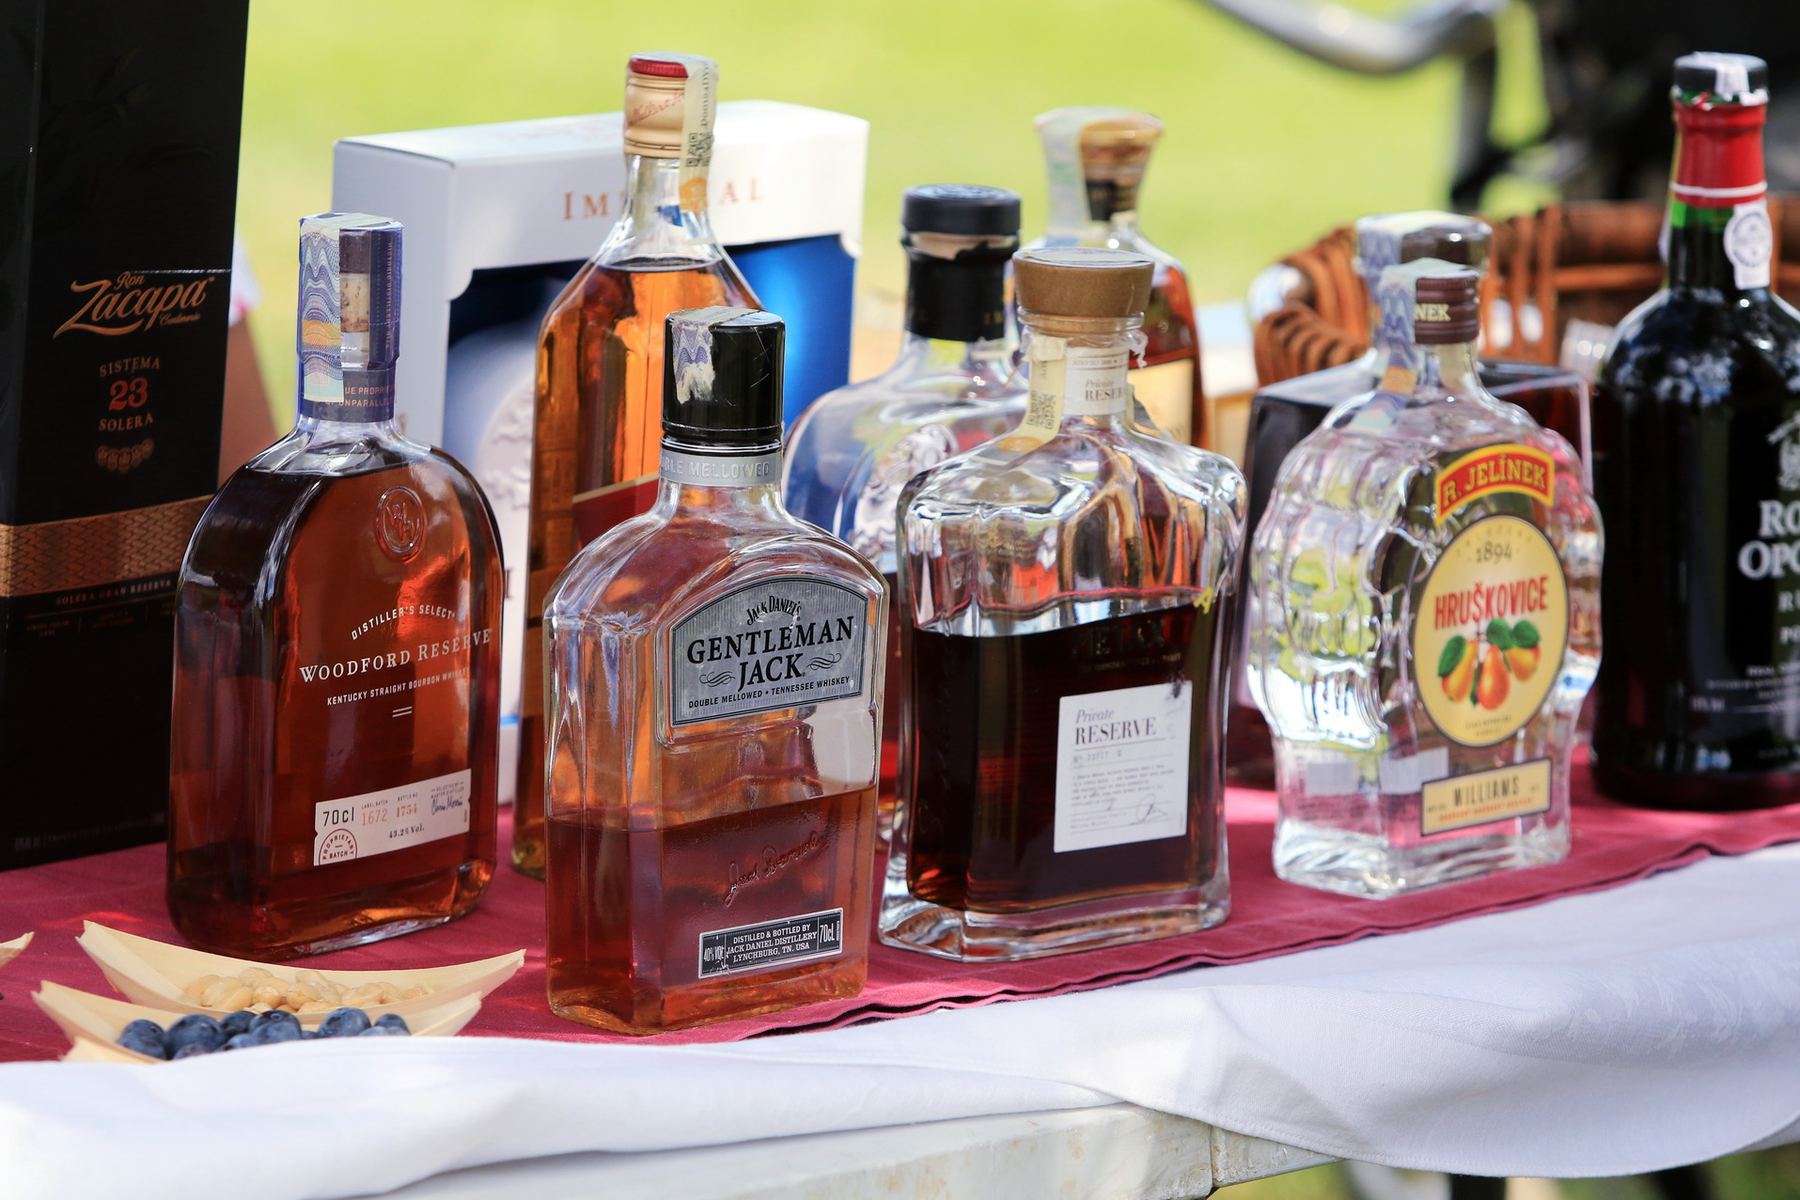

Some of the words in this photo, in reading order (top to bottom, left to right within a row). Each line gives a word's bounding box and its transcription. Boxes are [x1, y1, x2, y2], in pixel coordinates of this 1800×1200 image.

[115, 271, 145, 290] Ron
[52, 276, 215, 340] Zacapa
[1414, 303, 1451, 321] NEK
[99, 356, 161, 378] SISTEMA
[109, 377, 148, 411] 23
[98, 412, 154, 432] SOLERA
[689, 461, 770, 479] MELLOWED
[1466, 455, 1546, 492] JELÍNEK
[746, 602, 768, 626] JACK
[1434, 576, 1549, 631] HRUŠKOVICE
[351, 604, 415, 641] DISTILLER'S
[687, 615, 855, 665] GENTLEMAN
[299, 649, 411, 683] WOODFORD
[417, 628, 493, 662] RESERVE
[737, 652, 804, 692] JACK
[327, 690, 368, 706] KENTUCKY
[370, 682, 406, 699] STRAIGHT
[408, 675, 440, 690] BOURBON
[688, 696, 719, 709] DOUBLE
[721, 689, 763, 704] MELLOWED
[771, 682, 814, 696] TENNESSEE
[816, 676, 851, 689] WHISKEY
[1075, 708, 1114, 724] Private
[1074, 716, 1157, 746] RESERVE
[322, 806, 355, 827] 70cl
[361, 807, 389, 827] 1672
[329, 850, 348, 859] BATCH
[726, 944, 745, 956] JACK
[746, 939, 773, 953] DANIEL
[774, 931, 818, 947] DISTILLERY
[733, 932, 766, 945] DISTILLED
[766, 931, 771, 939] &
[772, 925, 801, 938] BOTTLED
[802, 923, 811, 932] BY
[796, 942, 810, 951] USA
